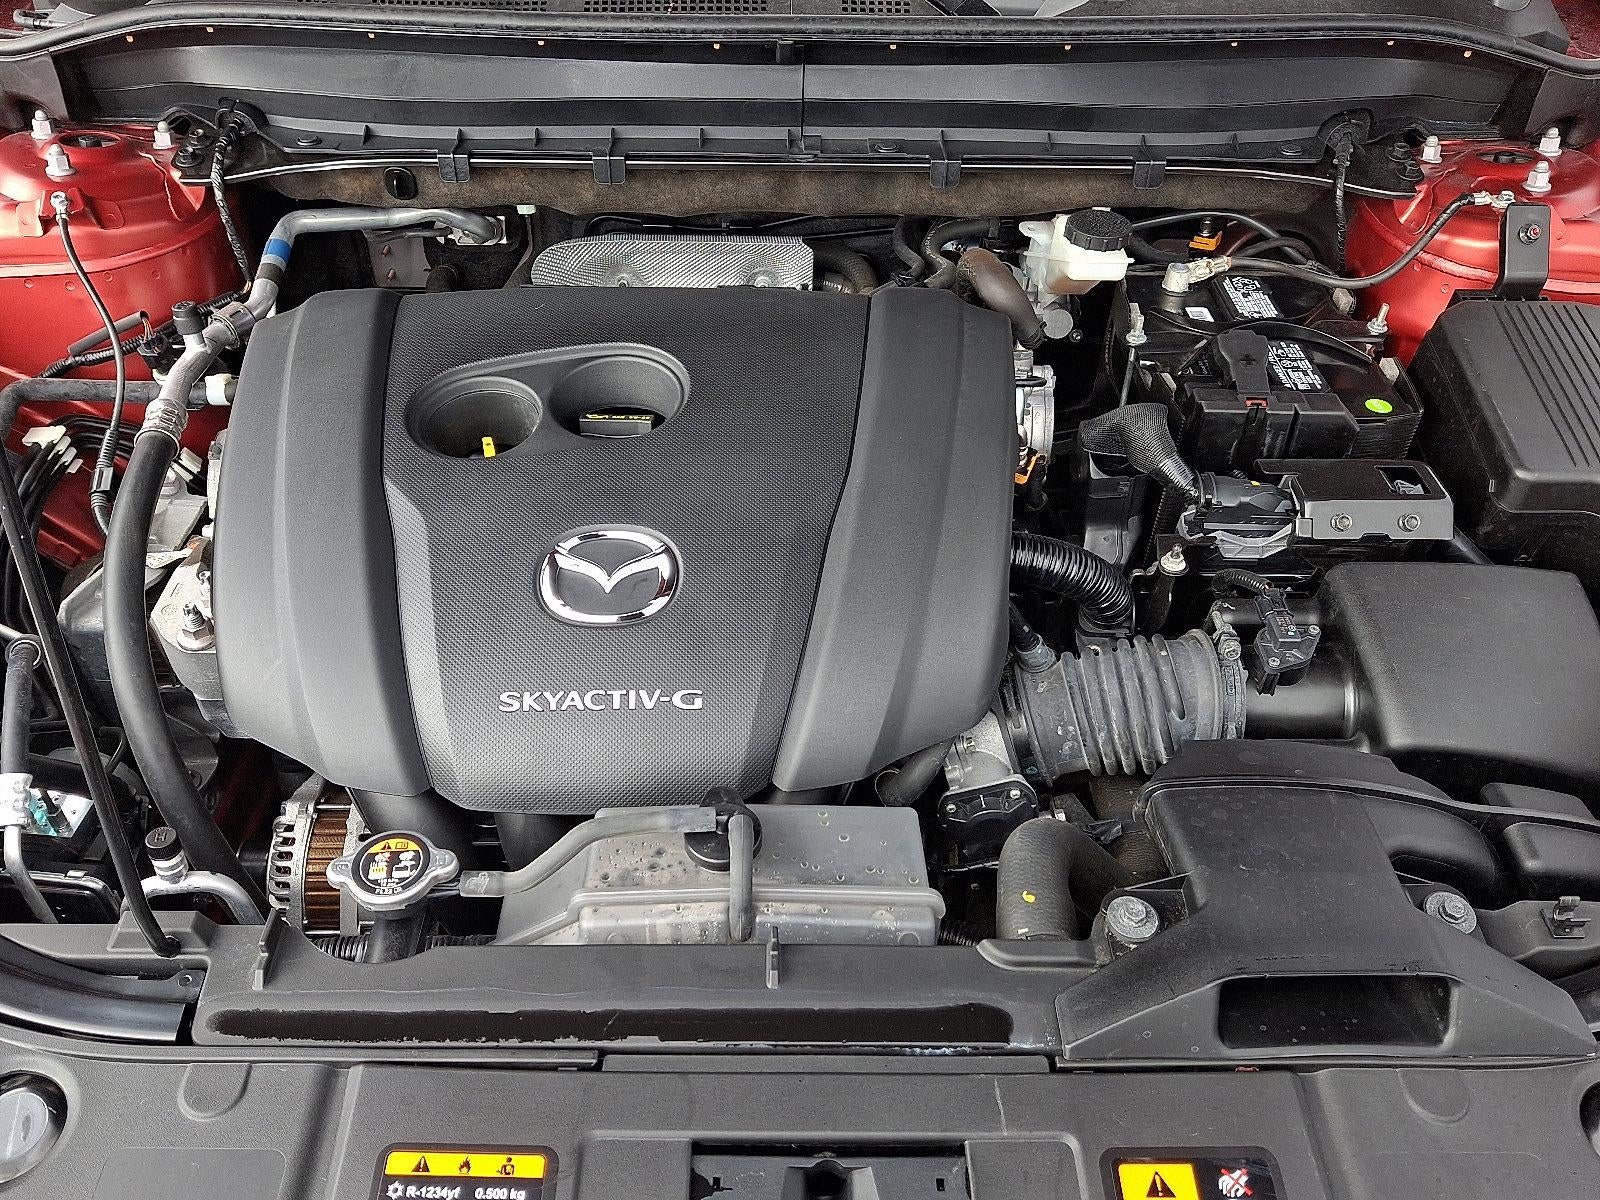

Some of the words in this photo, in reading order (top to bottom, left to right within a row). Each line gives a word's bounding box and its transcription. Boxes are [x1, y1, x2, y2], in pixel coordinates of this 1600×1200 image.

[498, 688, 703, 713] SKYACTIV-G
[405, 1185, 461, 1200] R-1234yf
[474, 1187, 508, 1200] 0.500
[509, 1187, 526, 1200] kg
